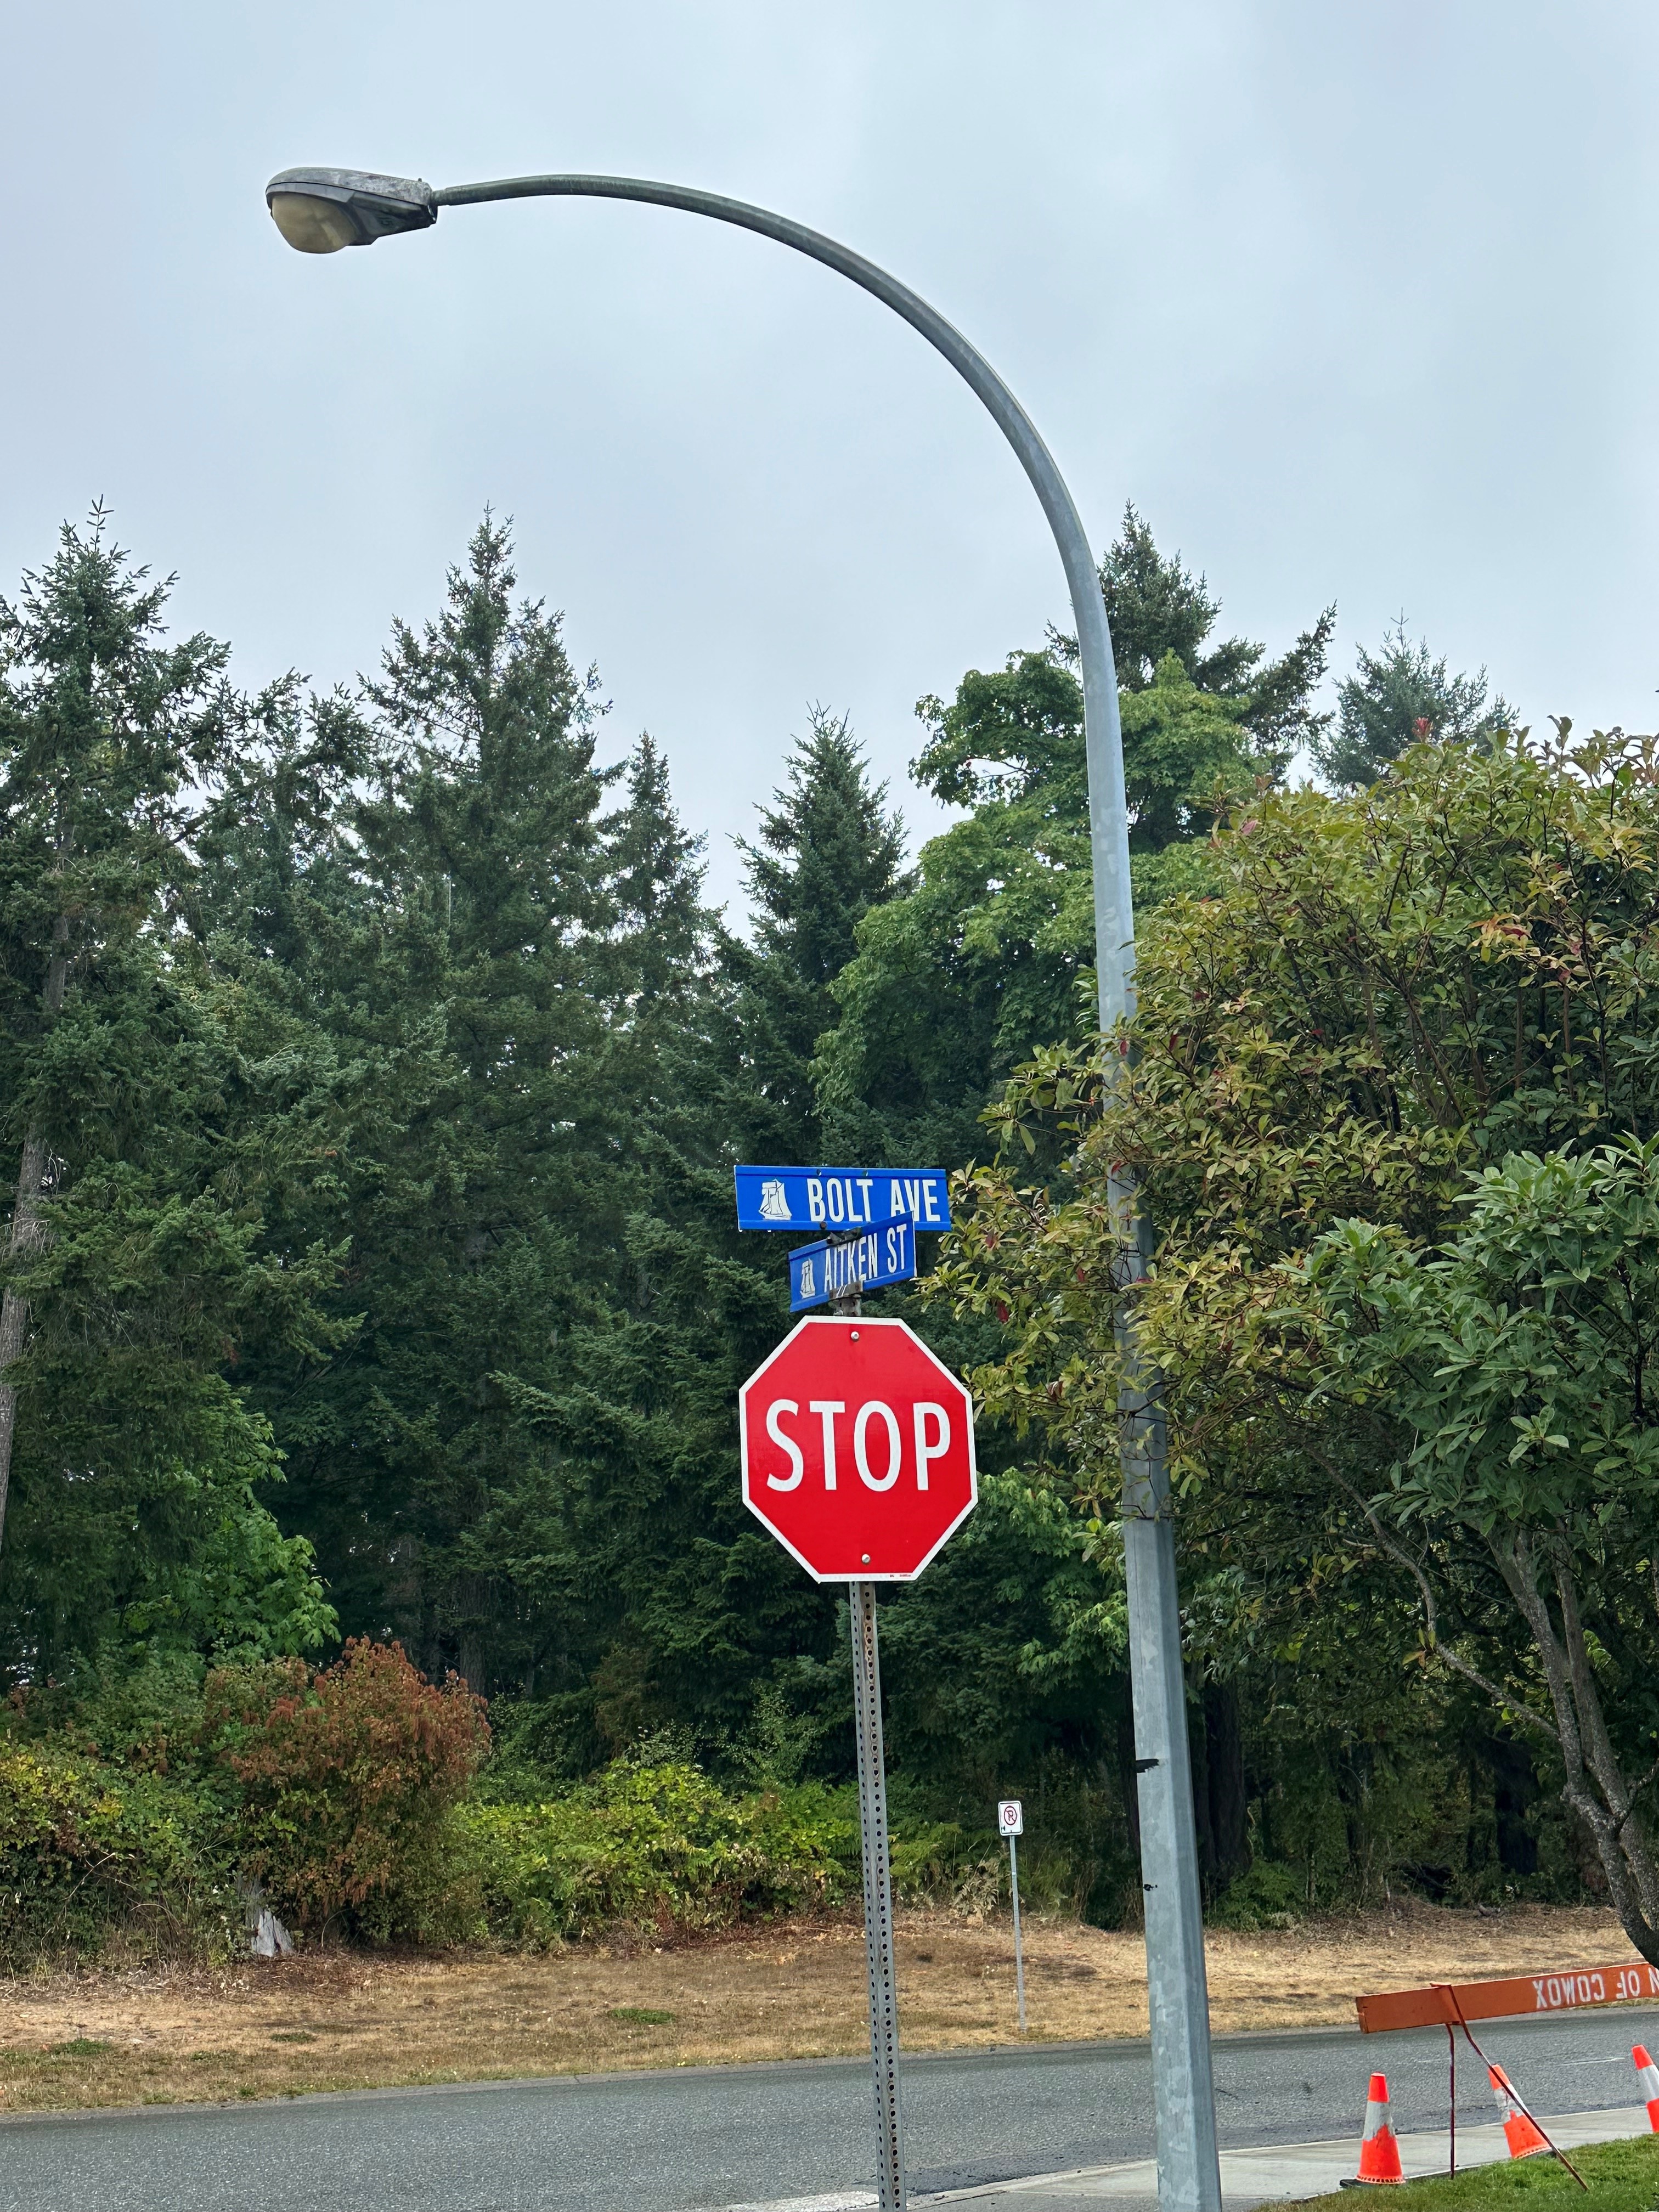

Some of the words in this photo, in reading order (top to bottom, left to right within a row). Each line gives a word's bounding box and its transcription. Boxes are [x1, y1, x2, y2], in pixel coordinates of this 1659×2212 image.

[807, 1178, 873, 1222] BOLT
[890, 1179, 941, 1222] AVE
[825, 1233, 878, 1293] AITKEN
[887, 1224, 907, 1273] ST
[766, 1399, 951, 1492] STOP
[1532, 1973, 1605, 2009] COMOX
[1616, 1970, 1640, 1999] OF
